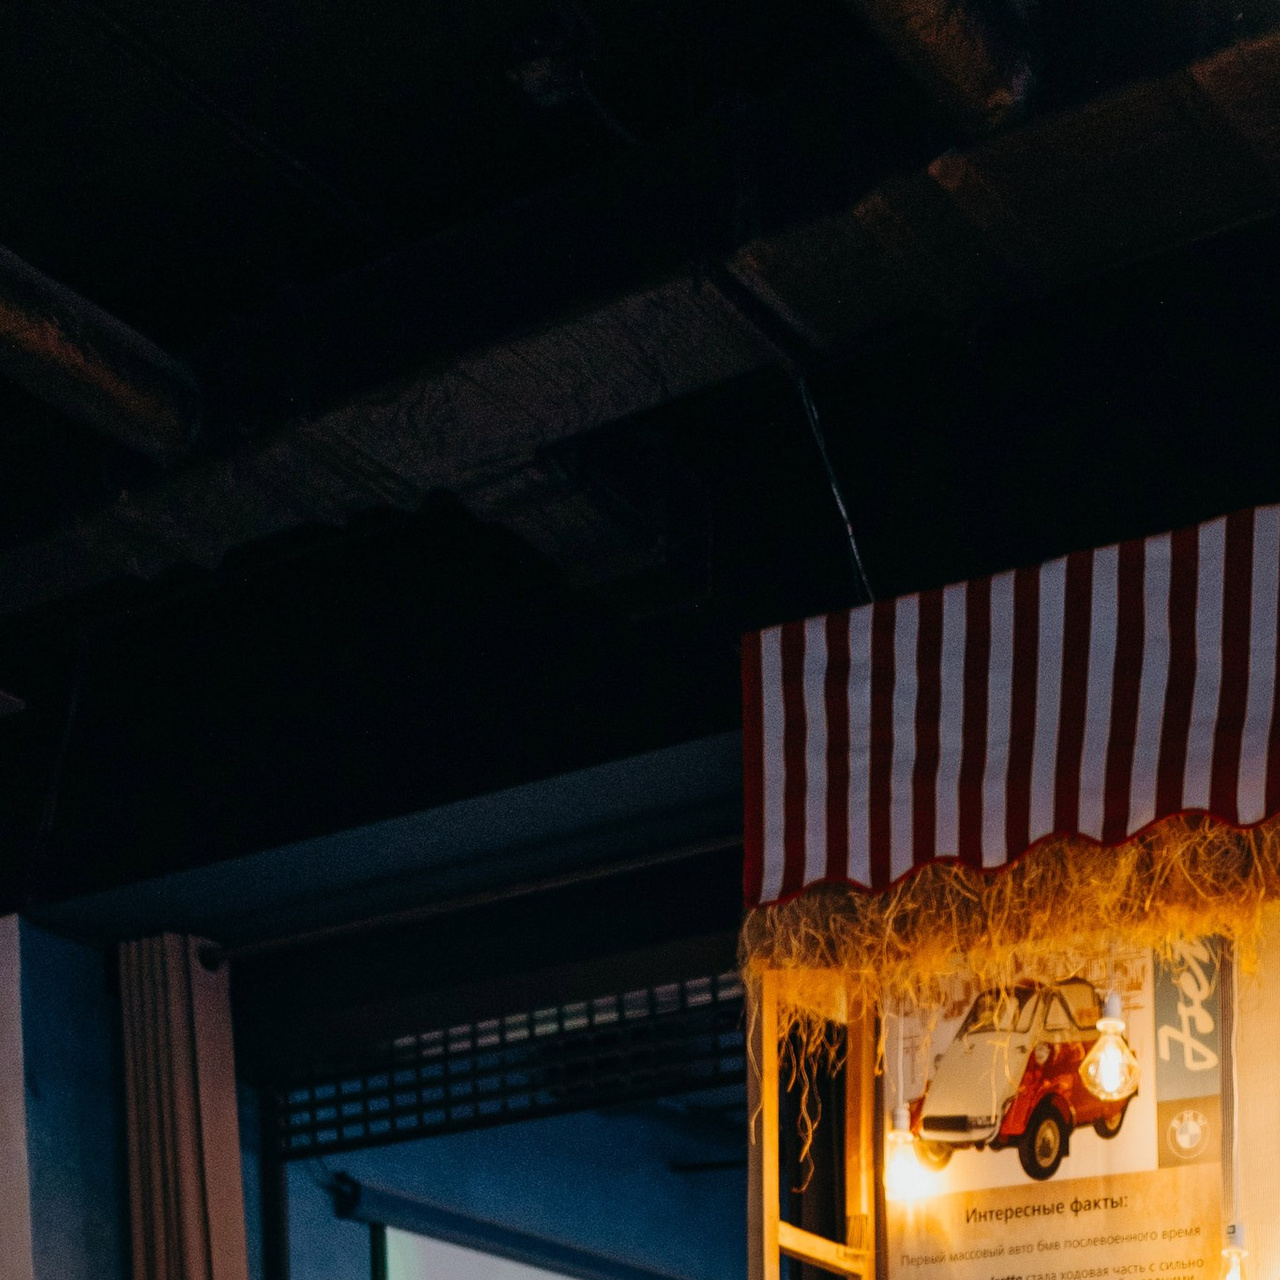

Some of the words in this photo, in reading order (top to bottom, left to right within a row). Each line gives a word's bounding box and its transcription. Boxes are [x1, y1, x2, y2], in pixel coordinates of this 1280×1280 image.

[964, 1203, 1065, 1222] Интересные
[1069, 1196, 1128, 1214] факты:
[1007, 1243, 1034, 1253] авто
[1063, 1231, 1158, 1248] послевоенного
[1160, 1227, 1201, 1241] время
[1059, 1267, 1109, 1280] ходовая
[1112, 1264, 1146, 1275] часть
[1158, 1259, 1204, 1271] сильно
